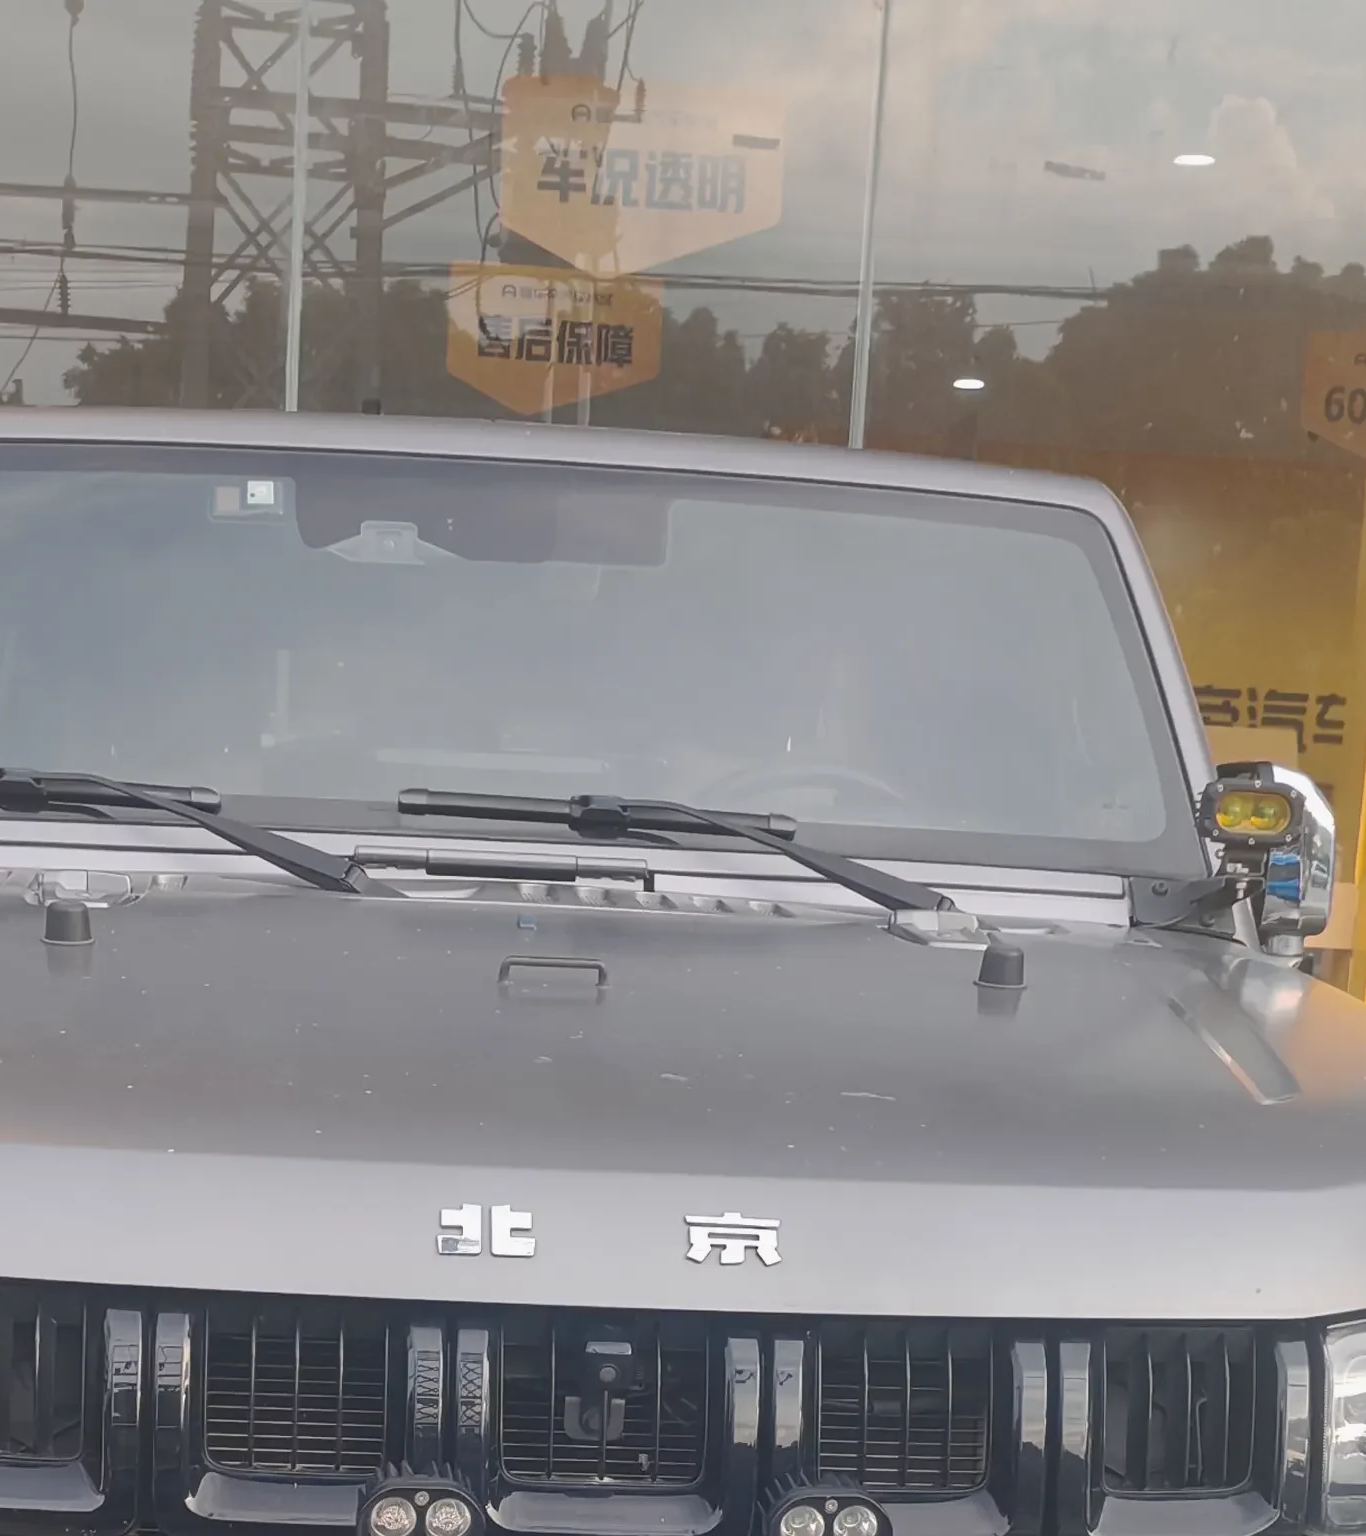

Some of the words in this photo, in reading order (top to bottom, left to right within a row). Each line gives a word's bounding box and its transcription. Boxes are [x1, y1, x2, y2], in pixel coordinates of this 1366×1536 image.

[477, 314, 635, 369] 售后保障
[436, 1203, 783, 1267] 北京
